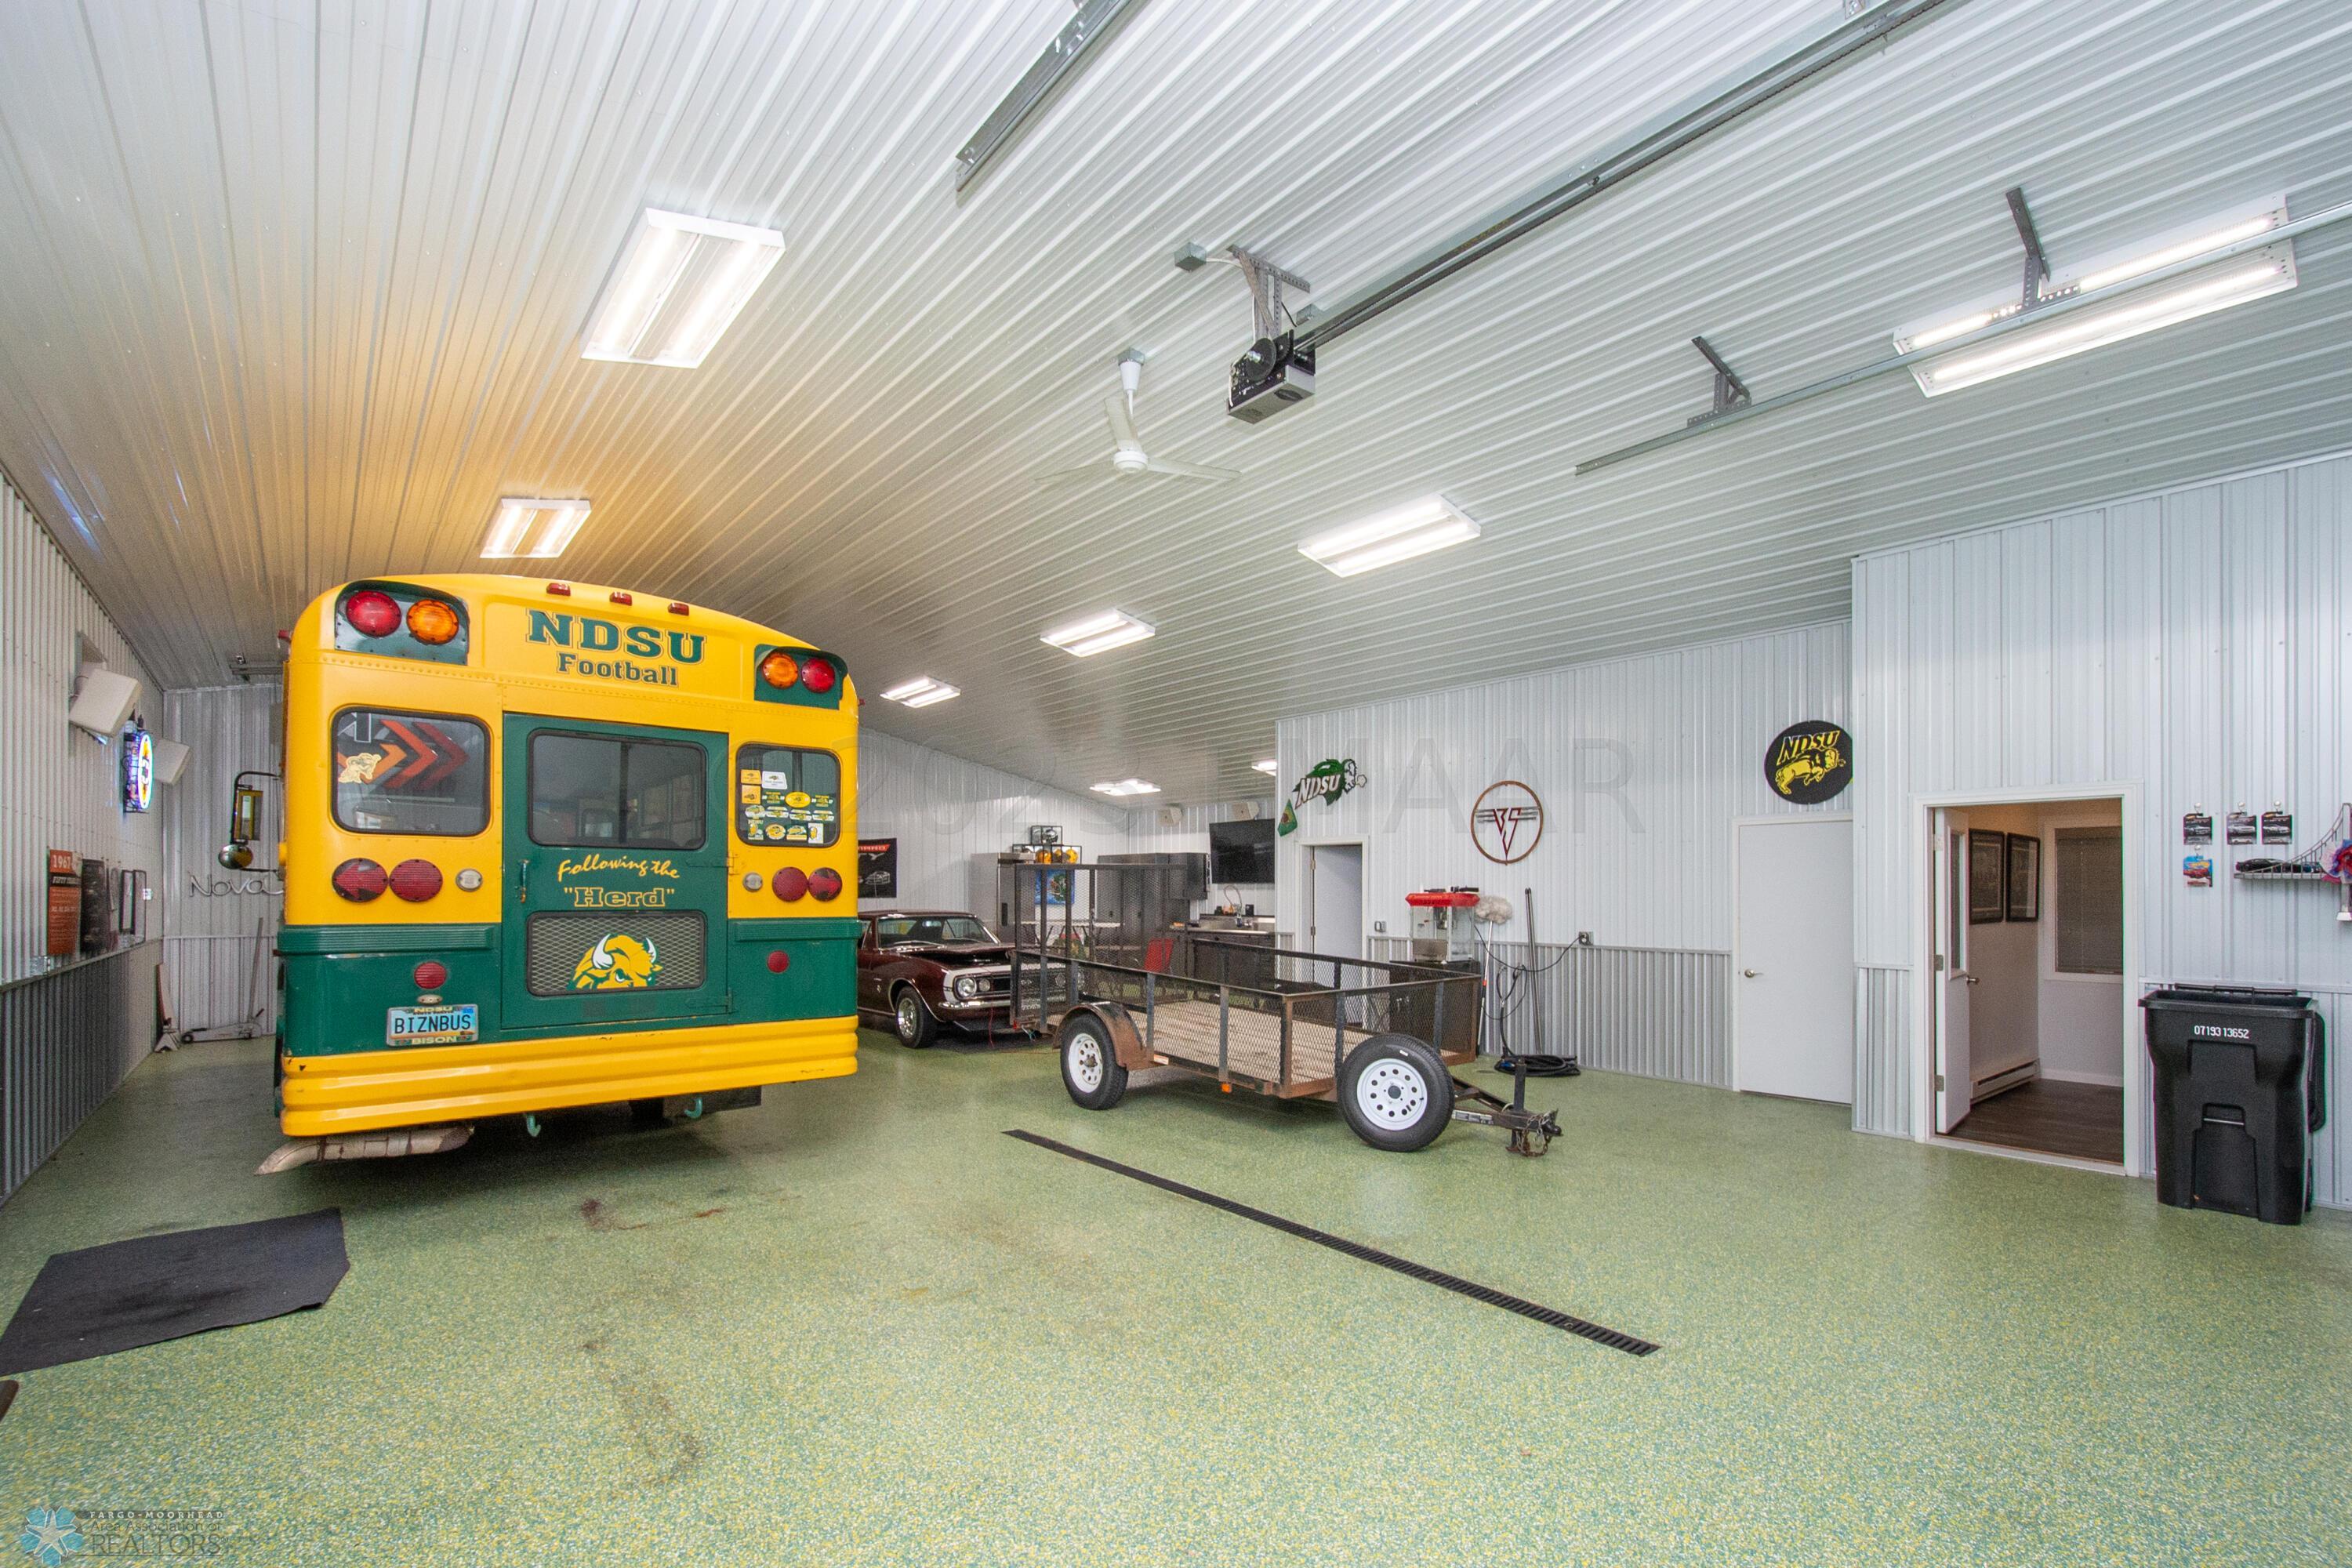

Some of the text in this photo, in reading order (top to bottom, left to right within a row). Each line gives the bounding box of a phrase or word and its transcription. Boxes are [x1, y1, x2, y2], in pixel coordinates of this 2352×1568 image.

[526, 608, 707, 665] NDSU
[557, 652, 679, 688] Football
[1776, 730, 1840, 766] NDSU
[1295, 774, 1341, 810] NDSU
[53, 855, 71, 869] 1967
[557, 854, 681, 882] Following the
[188, 873, 285, 898] Nova
[564, 887, 675, 908] "Herd"
[394, 1014, 471, 1034] BIZNBUS
